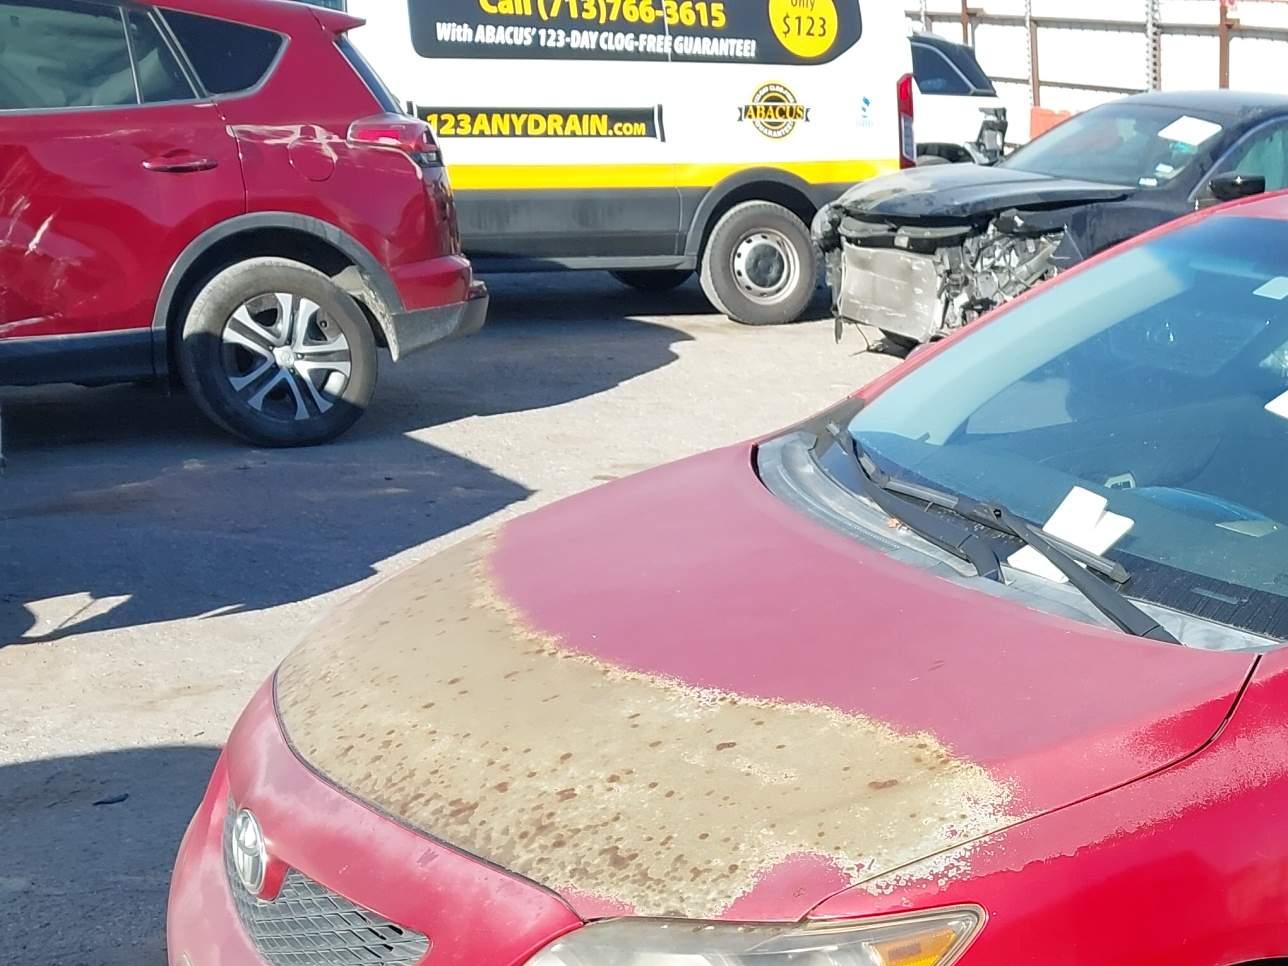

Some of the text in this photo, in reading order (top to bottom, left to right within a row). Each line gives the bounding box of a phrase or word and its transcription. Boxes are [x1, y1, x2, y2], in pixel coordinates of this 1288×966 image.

[782, 12, 827, 38] $123
[435, 22, 473, 43] With
[538, 28, 599, 50] 123-DAY
[599, 31, 673, 53] CLOG-FREE
[673, 35, 757, 57] GUARANTEE!
[746, 104, 805, 120] ABACUS
